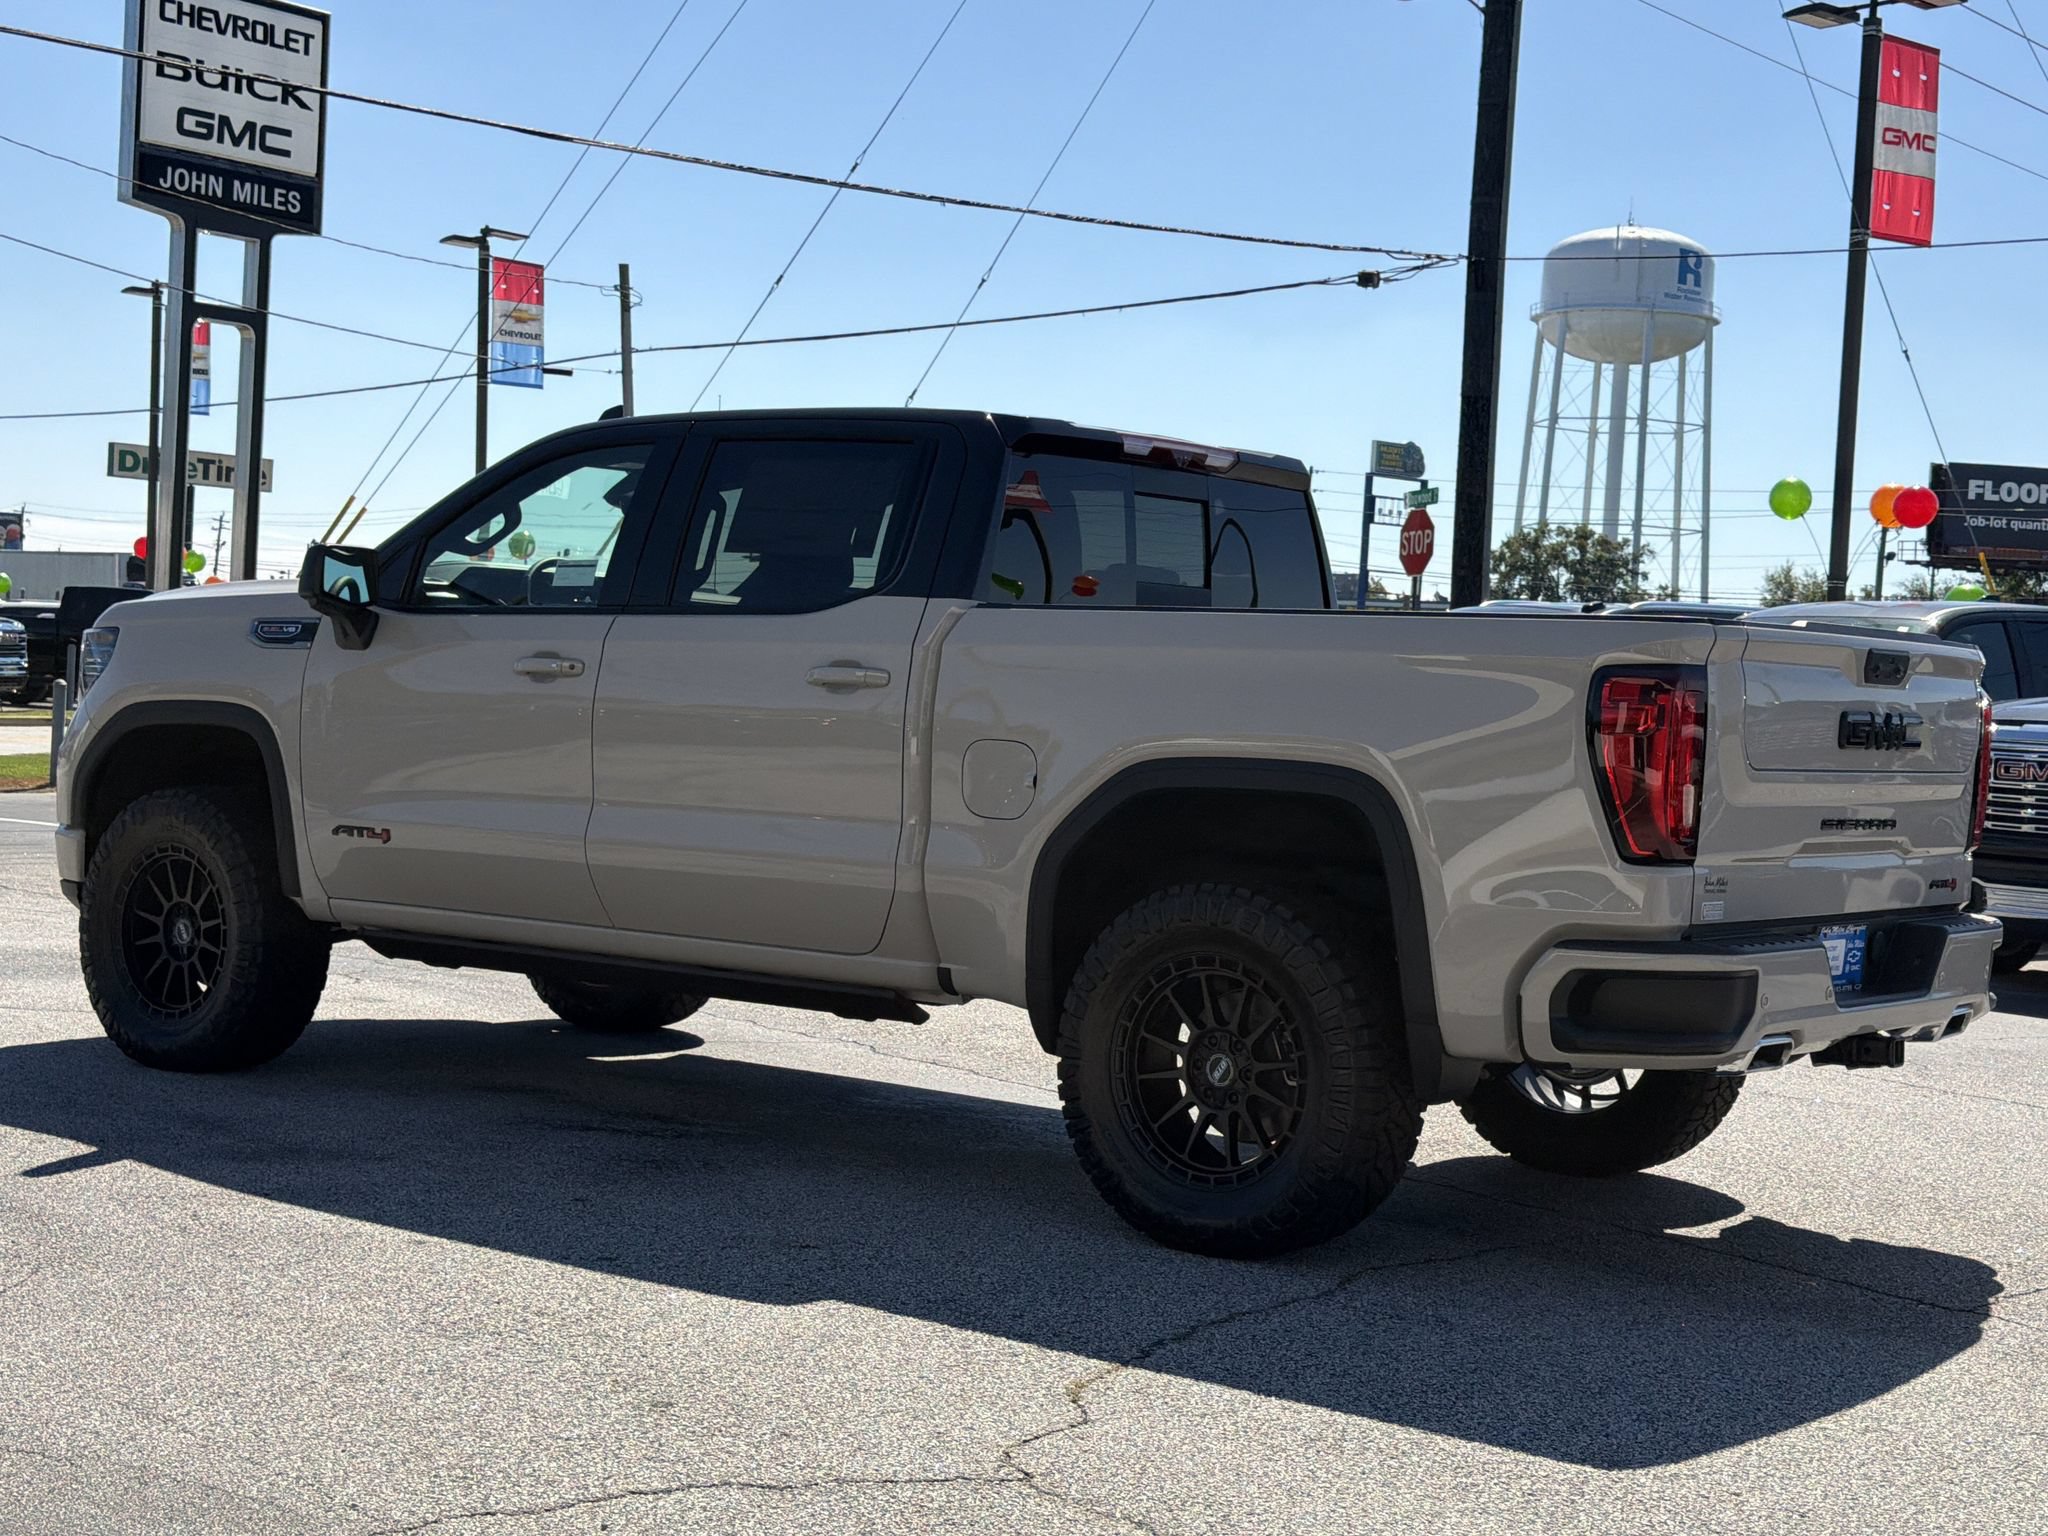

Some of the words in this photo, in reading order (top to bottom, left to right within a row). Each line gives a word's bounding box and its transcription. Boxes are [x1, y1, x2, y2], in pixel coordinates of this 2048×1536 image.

[158, 0, 315, 56] CHEVROLET
[176, 106, 293, 158] GMC
[1882, 127, 1936, 154] GMC
[159, 166, 223, 198] JOHN
[233, 179, 301, 213] MILES
[499, 329, 542, 340] CHEVROLET
[1402, 530, 1431, 556] STOP
[1838, 711, 1923, 750] GMC
[331, 825, 391, 844] AT4
[1820, 818, 1897, 831] SIERRA
